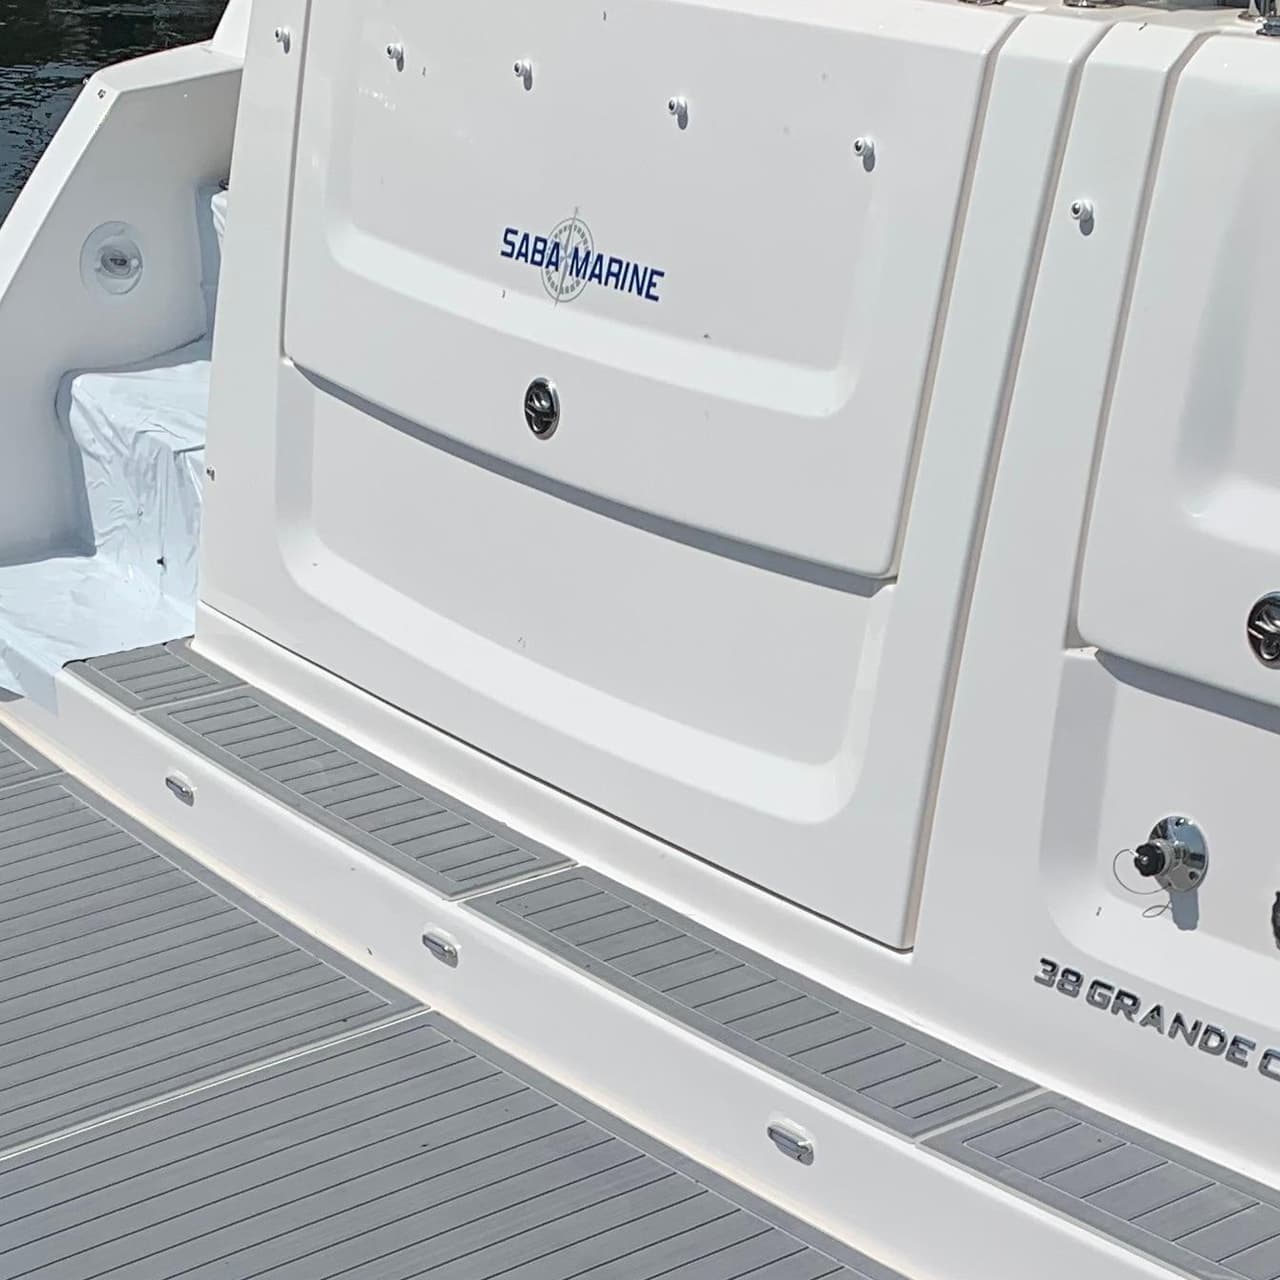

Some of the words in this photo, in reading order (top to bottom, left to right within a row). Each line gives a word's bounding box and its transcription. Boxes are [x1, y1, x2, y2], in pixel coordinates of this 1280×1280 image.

[500, 227, 561, 272] SABA
[568, 247, 665, 302] MARINE
[1033, 957, 1084, 998] 38
[1084, 979, 1256, 1068] GRANDE
